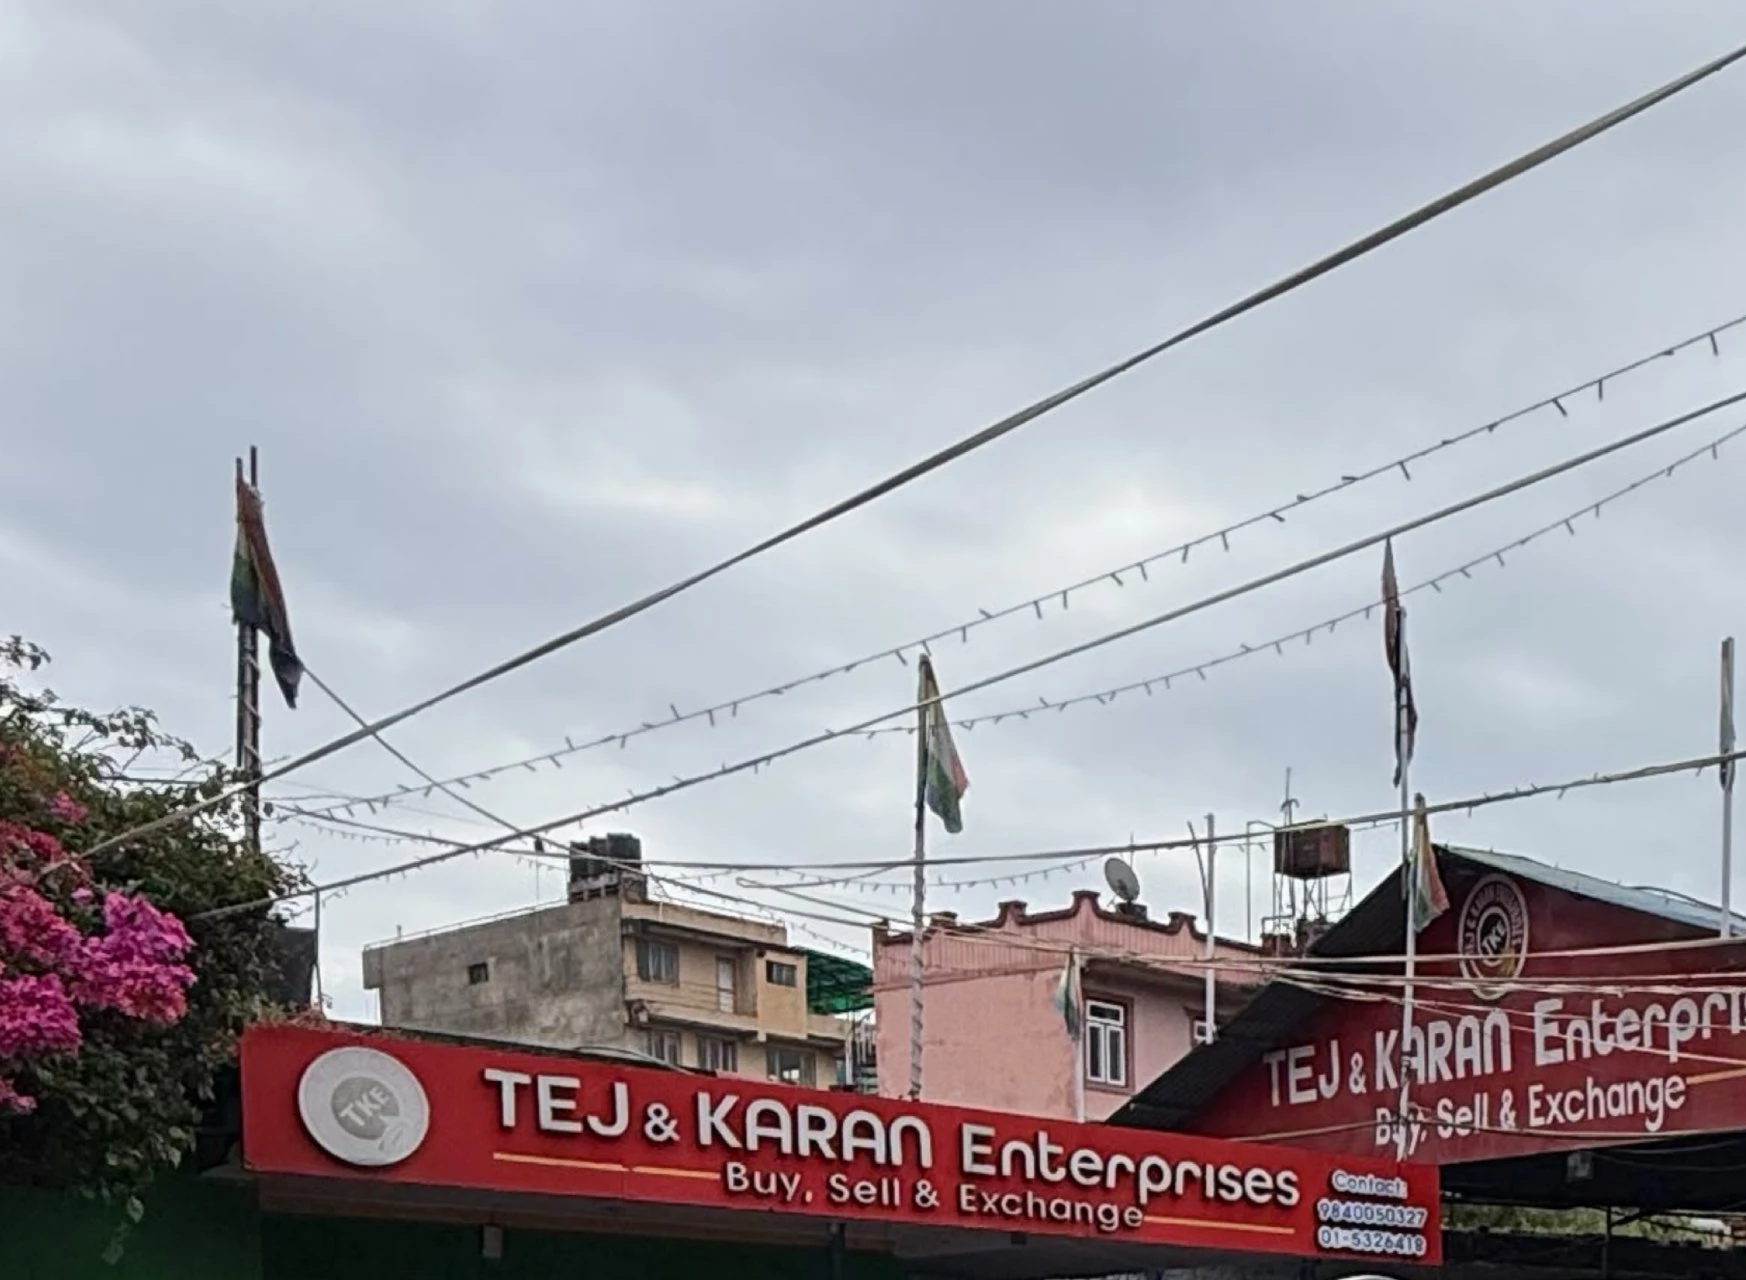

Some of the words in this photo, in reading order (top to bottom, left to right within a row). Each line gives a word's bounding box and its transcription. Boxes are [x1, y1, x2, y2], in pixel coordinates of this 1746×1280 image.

[1263, 1039, 1340, 1107] TEJ
[1349, 1051, 1367, 1094] &
[338, 1085, 391, 1127] TKE
[484, 1067, 629, 1138] TEJ
[643, 1102, 681, 1142] &
[698, 1091, 933, 1168] KARAN
[962, 1123, 1299, 1206] Enterprises
[1436, 1091, 1489, 1138] Sell
[1500, 1088, 1517, 1130] &
[1527, 1075, 1687, 1132] Exchange
[726, 1162, 813, 1202] Buy,
[829, 1173, 900, 1206] Sell
[914, 1180, 939, 1208] &
[959, 1185, 1144, 1232] Exchange
[1318, 1199, 1428, 1228] 9840050327
